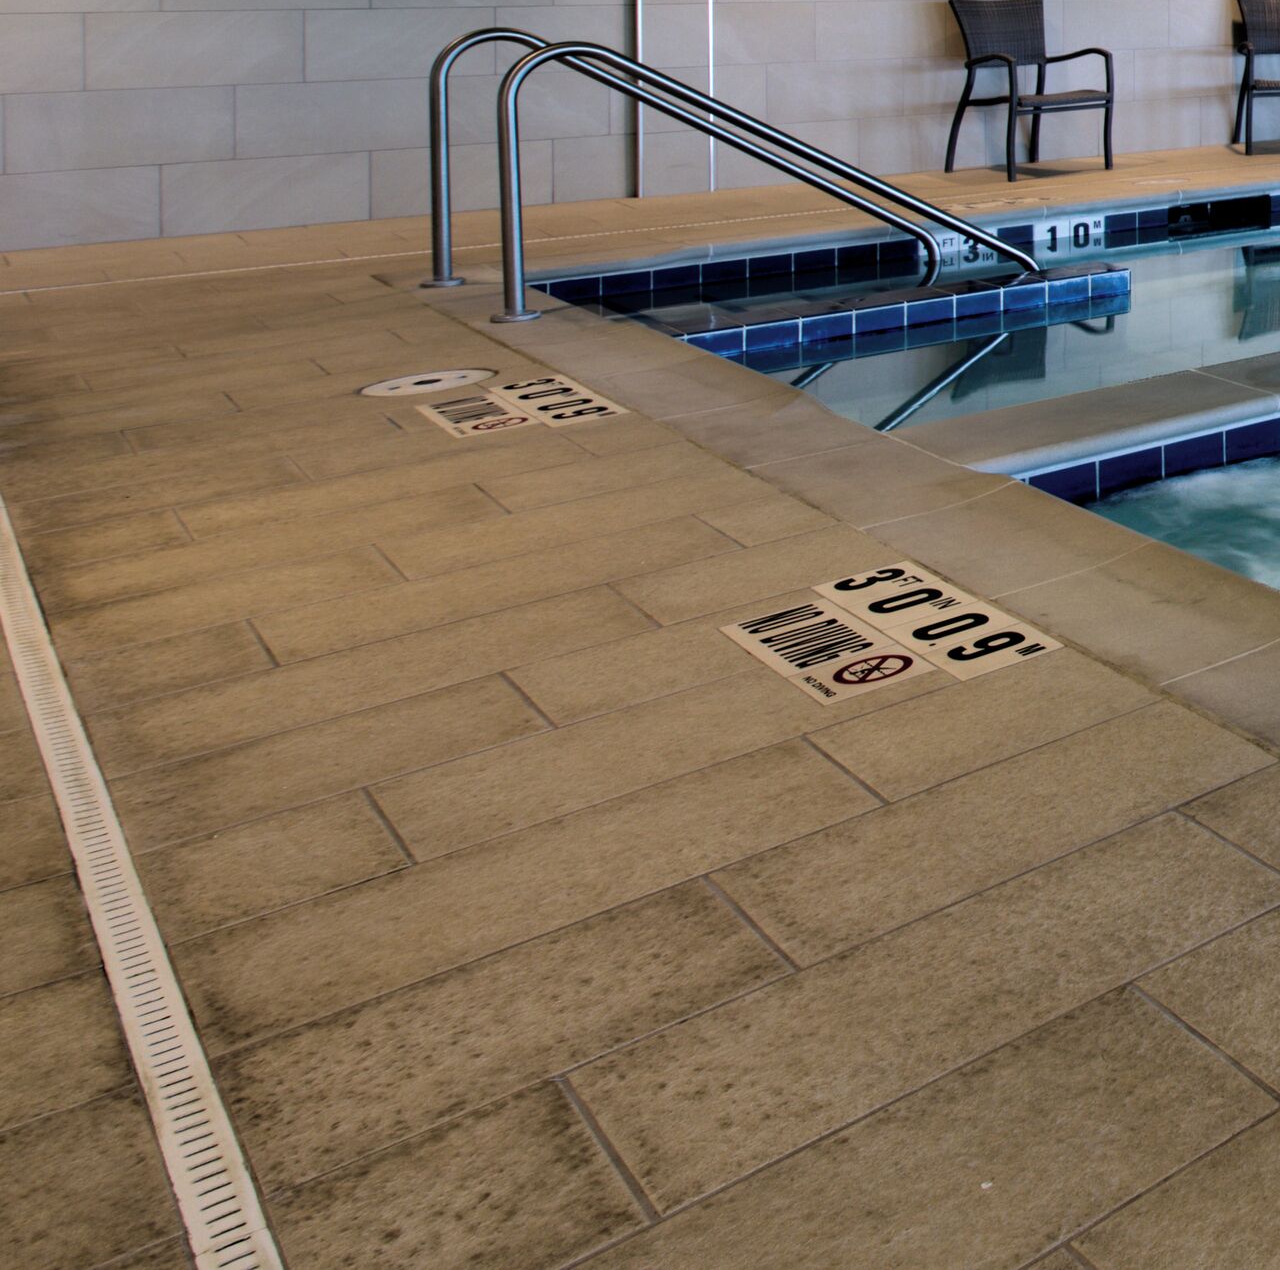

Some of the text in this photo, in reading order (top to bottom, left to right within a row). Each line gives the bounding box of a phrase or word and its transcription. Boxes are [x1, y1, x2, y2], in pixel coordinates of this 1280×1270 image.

[737, 603, 874, 669] NO DIVING
[812, 680, 837, 699] DIVING
